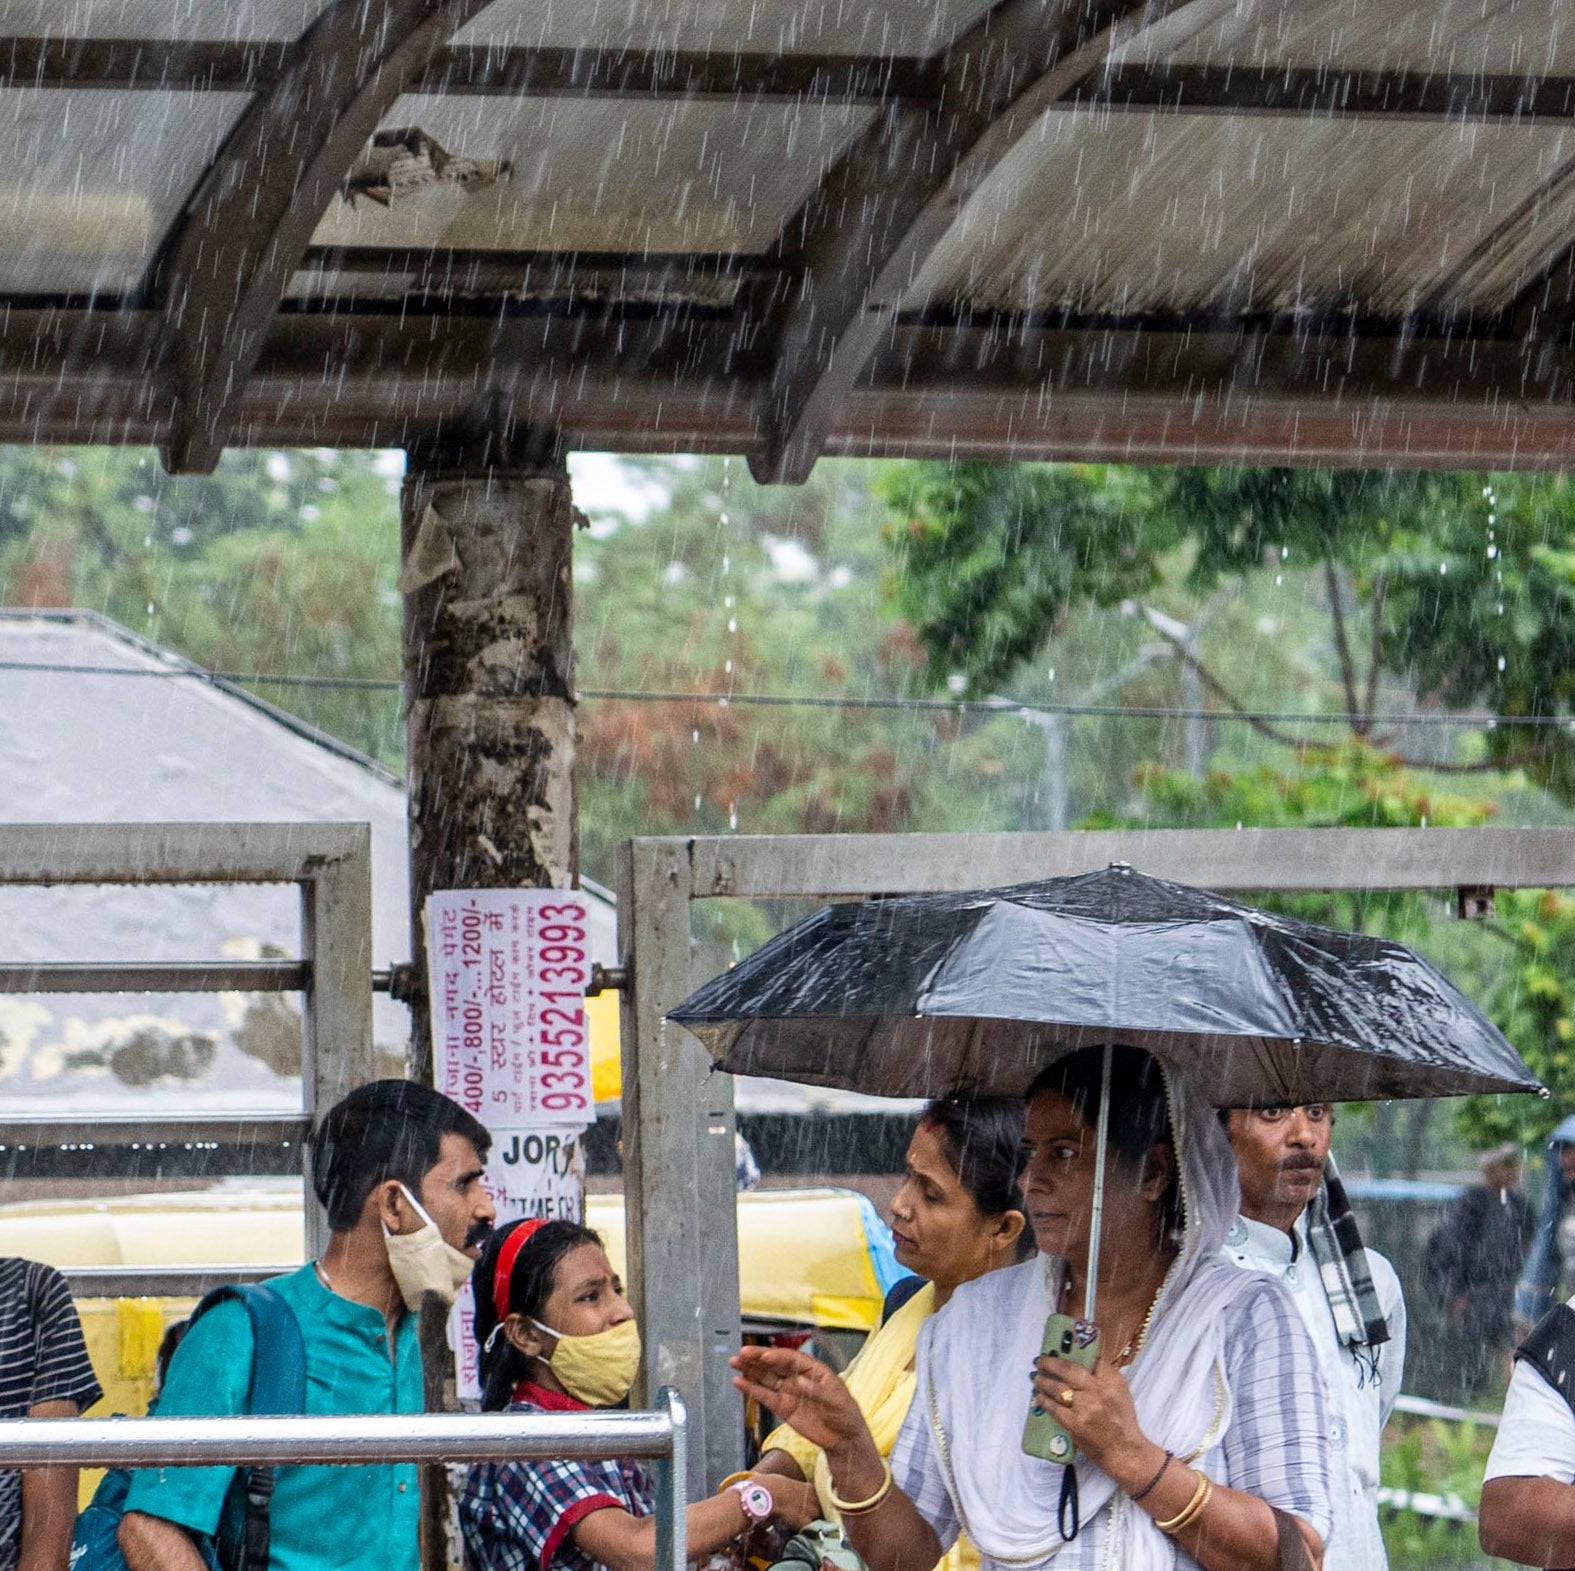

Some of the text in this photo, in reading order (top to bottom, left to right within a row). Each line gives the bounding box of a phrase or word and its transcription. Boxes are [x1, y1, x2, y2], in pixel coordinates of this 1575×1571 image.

[483, 912, 504, 931] में
[539, 904, 587, 1110] 9355213993
[492, 1090, 507, 1103] 5
